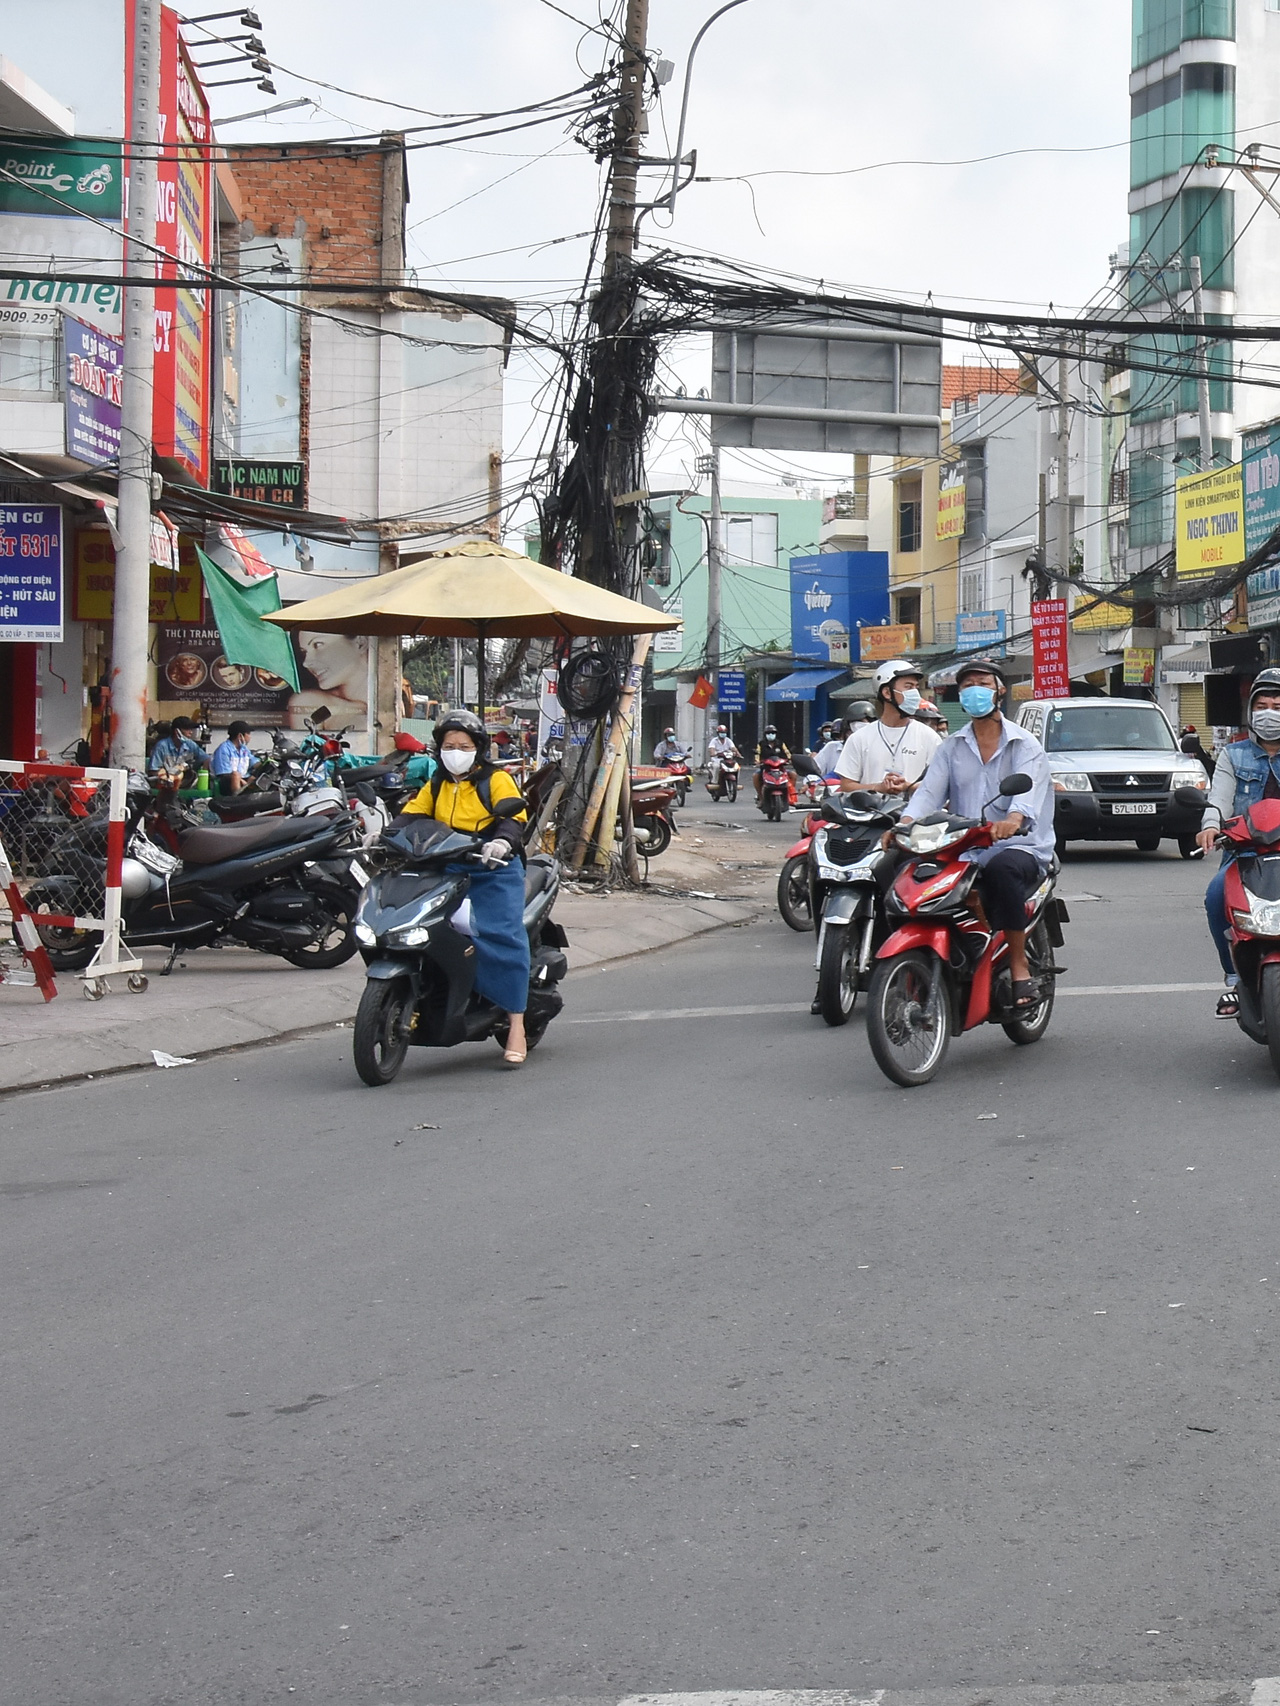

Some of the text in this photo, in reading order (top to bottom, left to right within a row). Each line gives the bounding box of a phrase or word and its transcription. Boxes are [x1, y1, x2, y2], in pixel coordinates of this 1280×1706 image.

[4, 159, 56, 177] Point
[219, 464, 302, 487] TÓC NAM NỮ
[1184, 488, 1241, 509] LINH KIỆN SMARTPHONES
[22, 511, 44, 525] CƠ
[1186, 516, 1209, 543] NGỌC
[1210, 510, 1239, 539] THỊNH
[1200, 546, 1223, 563] MOBILE
[21, 575, 32, 585] CƠ
[33, 574, 52, 587] ĐIỆN
[12, 588, 56, 602] HÚT SÂU
[1114, 804, 1154, 814] 57L-1023
